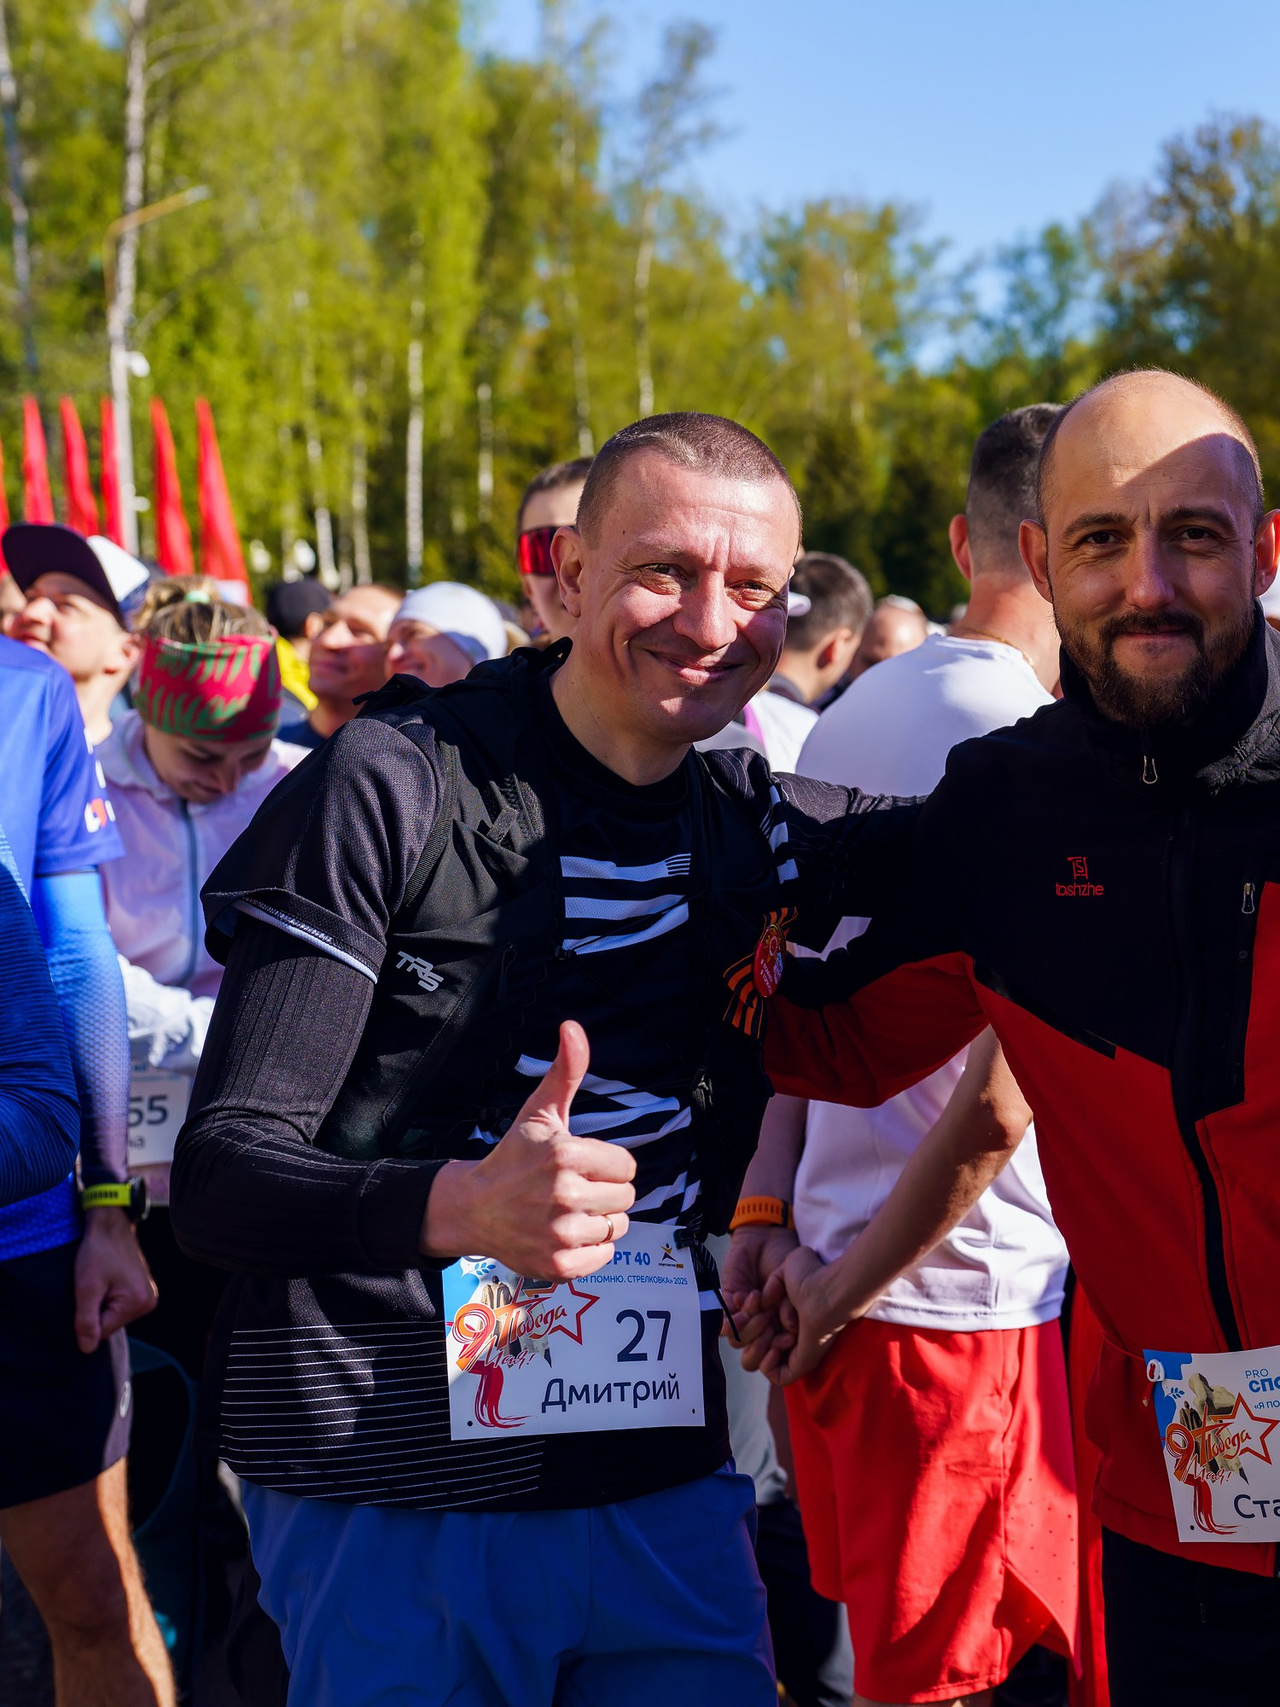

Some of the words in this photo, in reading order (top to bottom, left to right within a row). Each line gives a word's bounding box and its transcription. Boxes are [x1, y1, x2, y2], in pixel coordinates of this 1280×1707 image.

[395, 950, 445, 992] TRS
[634, 1251, 651, 1266] 40
[590, 1275, 626, 1284] ПОМНЮ.
[674, 1277, 689, 1285] 2025
[616, 1308, 672, 1363] 27
[1245, 1368, 1269, 1379] PRO
[541, 1373, 680, 1413] Дмитрий
